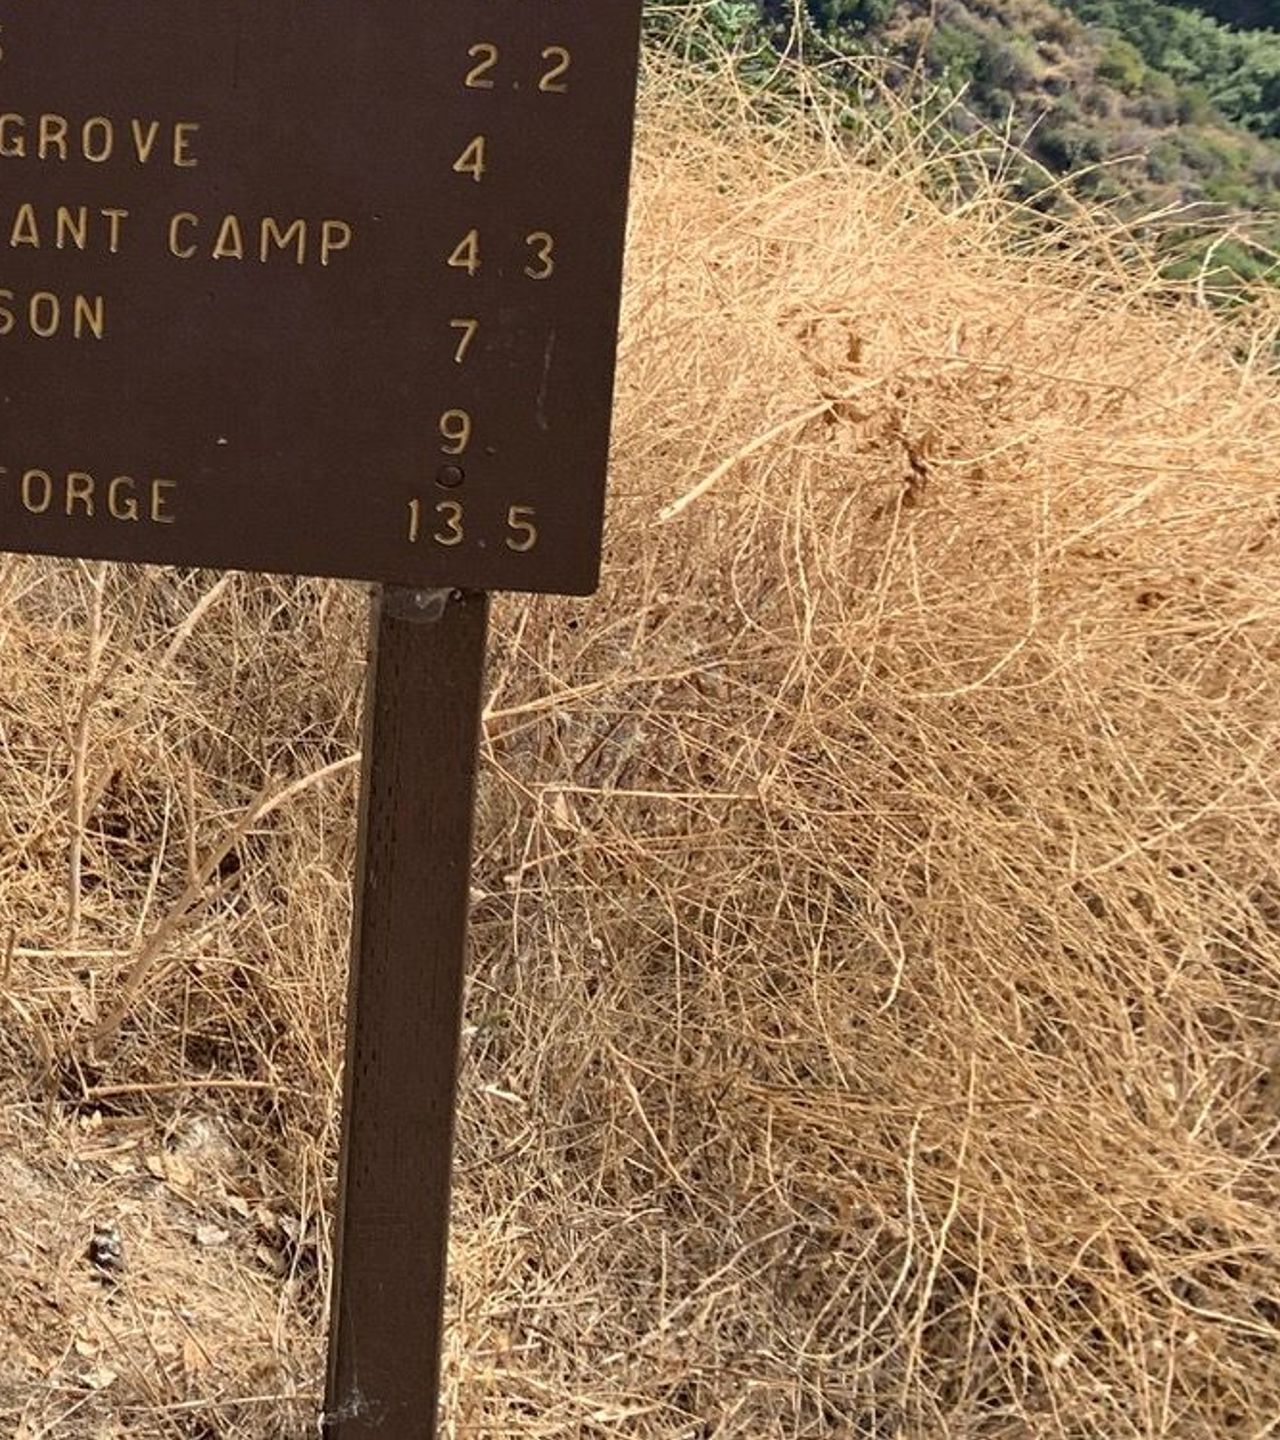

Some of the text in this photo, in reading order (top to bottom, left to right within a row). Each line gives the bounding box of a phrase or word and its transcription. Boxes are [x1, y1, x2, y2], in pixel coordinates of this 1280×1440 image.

[452, 135, 486, 182] 4
[169, 211, 352, 267] CAMP
[450, 319, 478, 364] 7
[439, 408, 471, 455] 9
